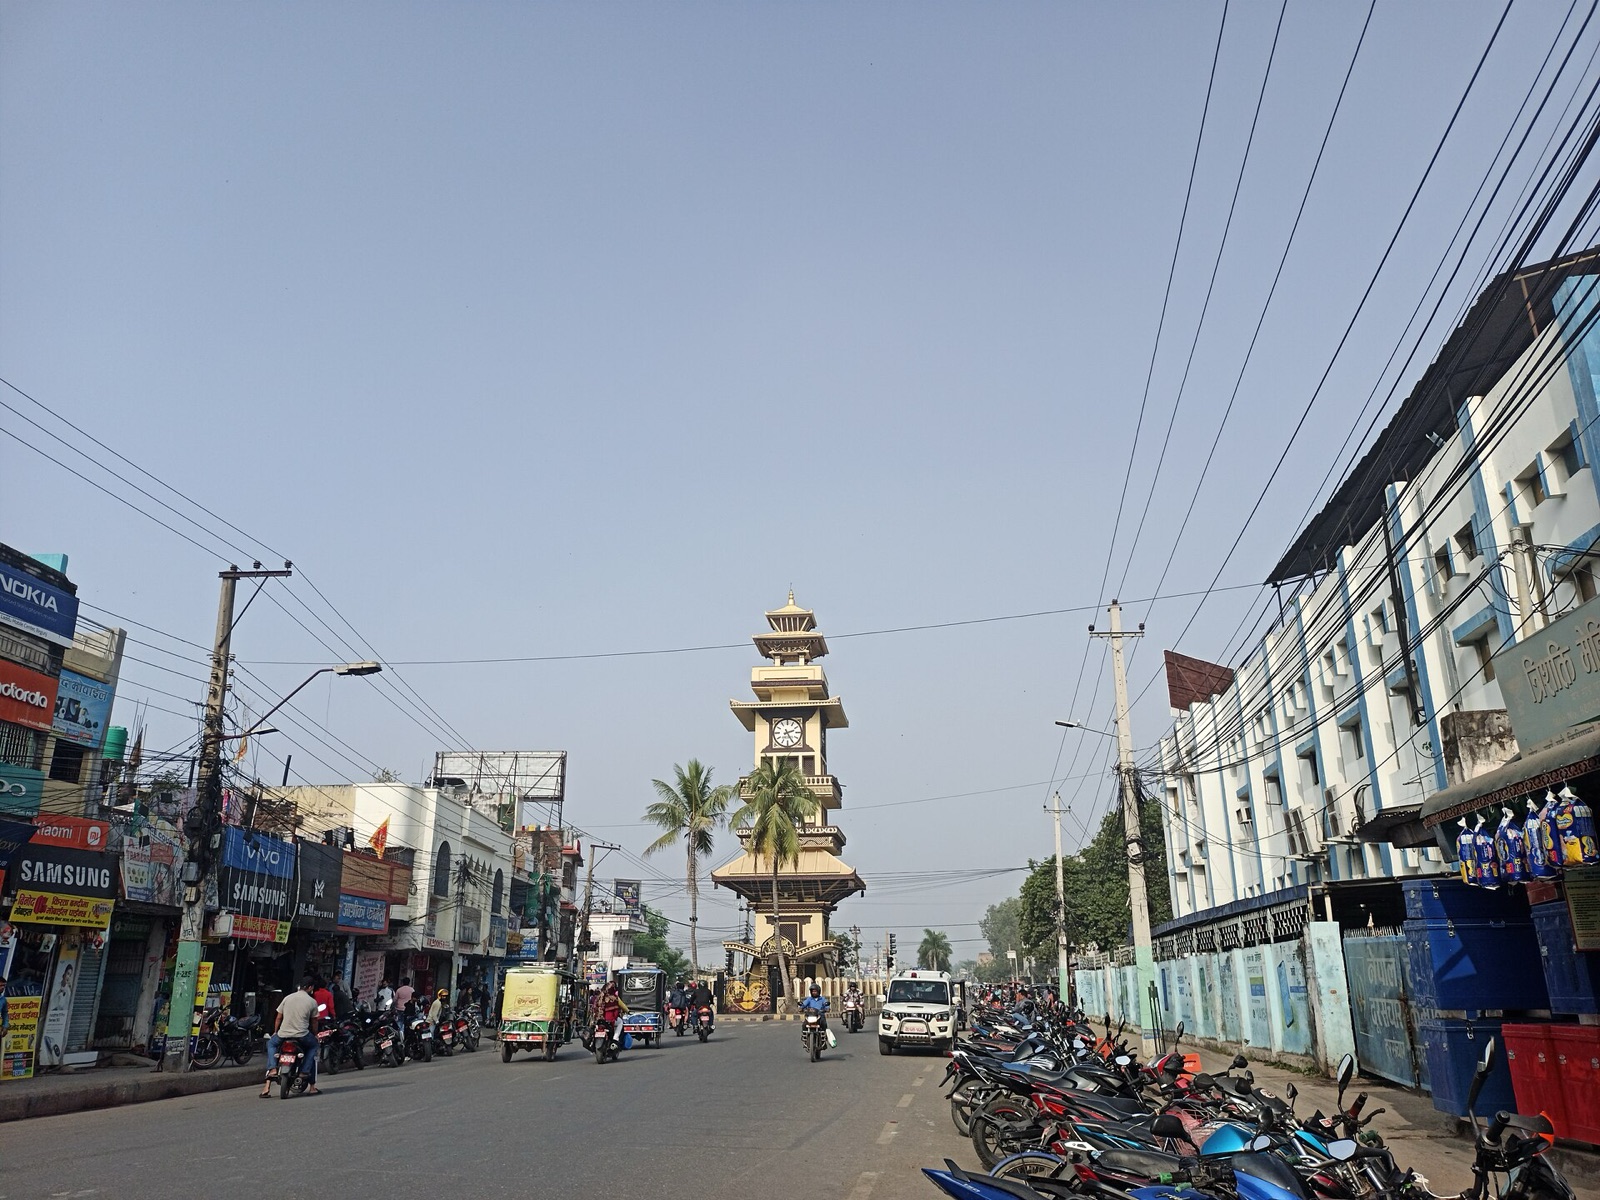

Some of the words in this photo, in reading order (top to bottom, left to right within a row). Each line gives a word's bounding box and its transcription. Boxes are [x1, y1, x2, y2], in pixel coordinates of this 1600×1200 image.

[0, 573, 58, 613] NOKIA
[0, 682, 48, 708] otorola
[21, 860, 110, 889] SAMSUNG
[233, 883, 286, 907] SAMSUNG
